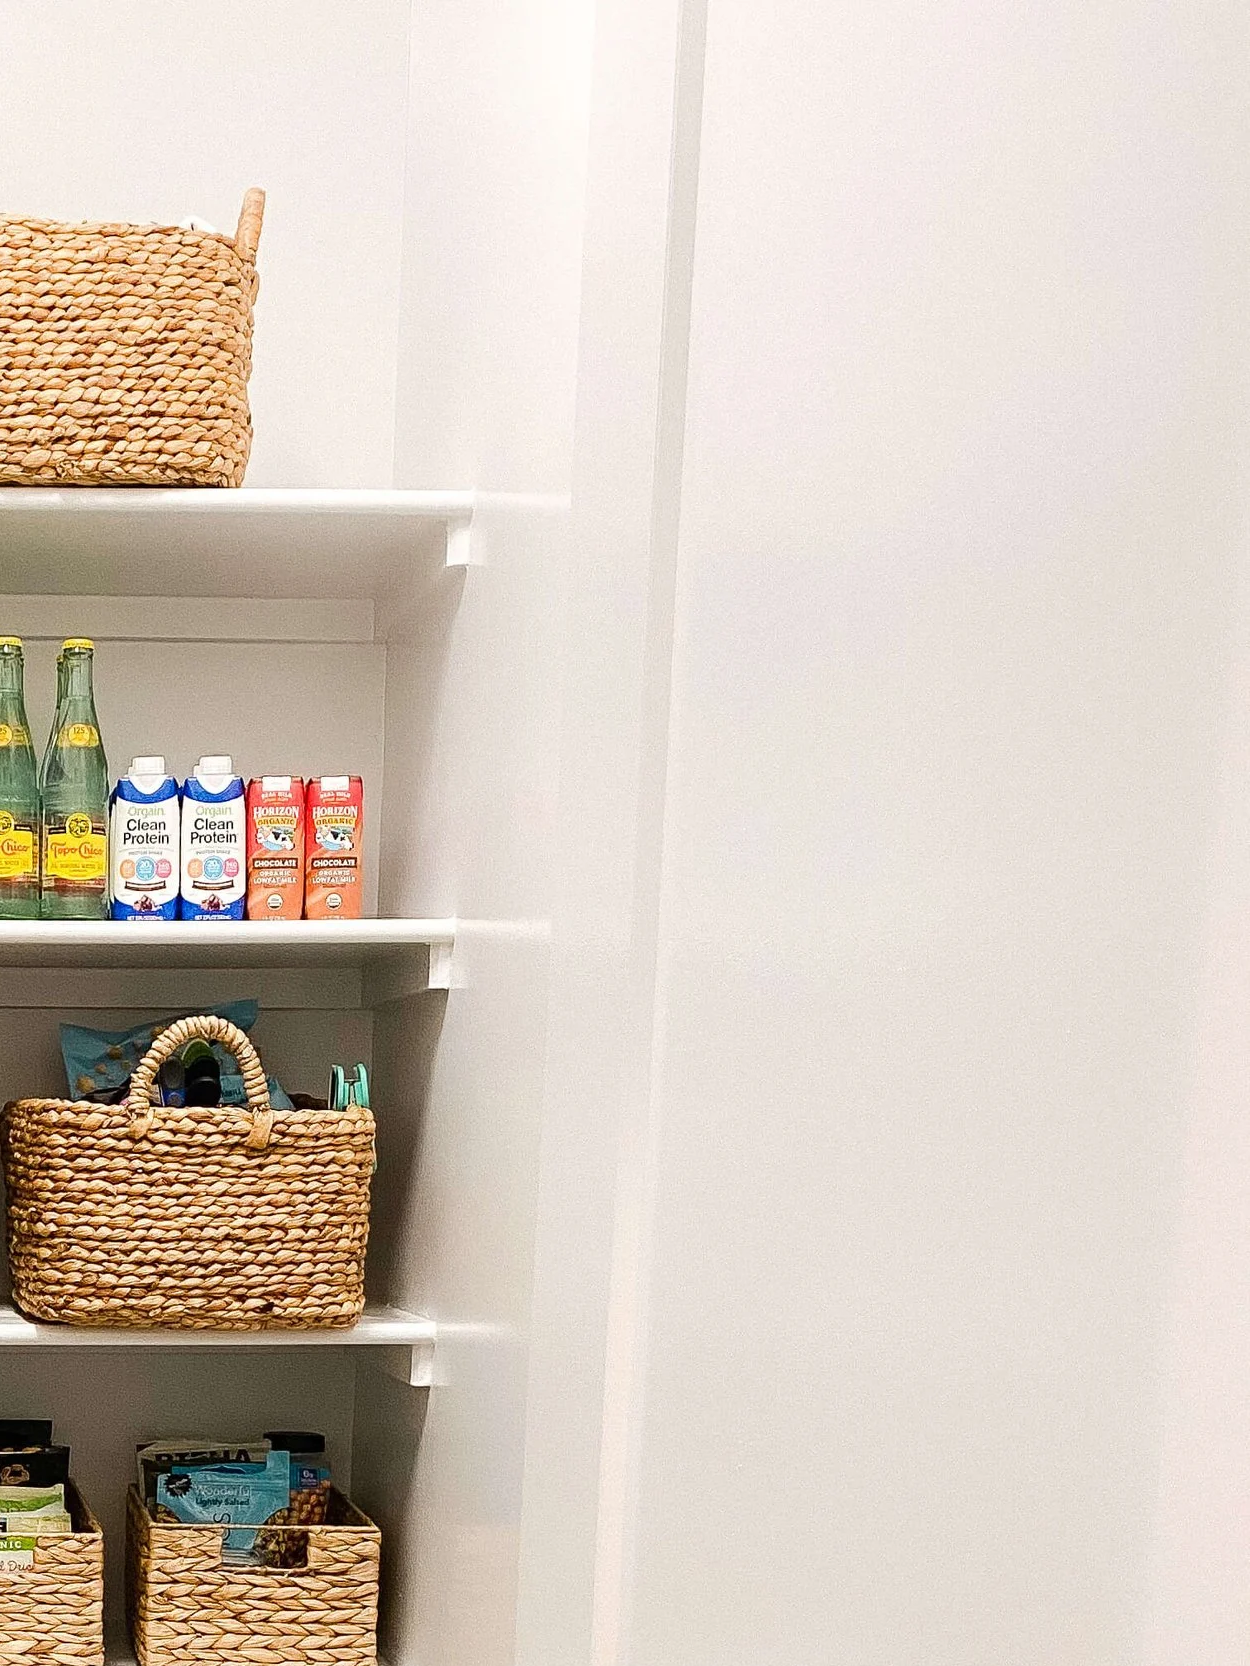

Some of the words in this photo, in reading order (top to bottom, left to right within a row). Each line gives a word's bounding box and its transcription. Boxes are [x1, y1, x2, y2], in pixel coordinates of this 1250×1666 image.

[73, 726, 85, 735] 125
[128, 806, 165, 819] Orgain
[195, 805, 232, 818] Orgain
[253, 806, 299, 819] HORIZON
[312, 806, 358, 819] HORIZON
[127, 818, 166, 831] Clean
[194, 818, 234, 830] Clean
[257, 818, 295, 826] ORGANIC
[316, 818, 354, 826] ORGANIC
[123, 831, 170, 845] Protein
[190, 830, 238, 844] Protein
[2, 838, 30, 856] Chico
[51, 842, 79, 858] Topo
[79, 841, 104, 858] Chico
[254, 859, 297, 867] CHOCOLATE
[313, 859, 356, 867] CHOCOLATE
[196, 1498, 222, 1507] Lightly
[224, 1497, 250, 1506] Salted
[7, 1560, 34, 1572] Drie
